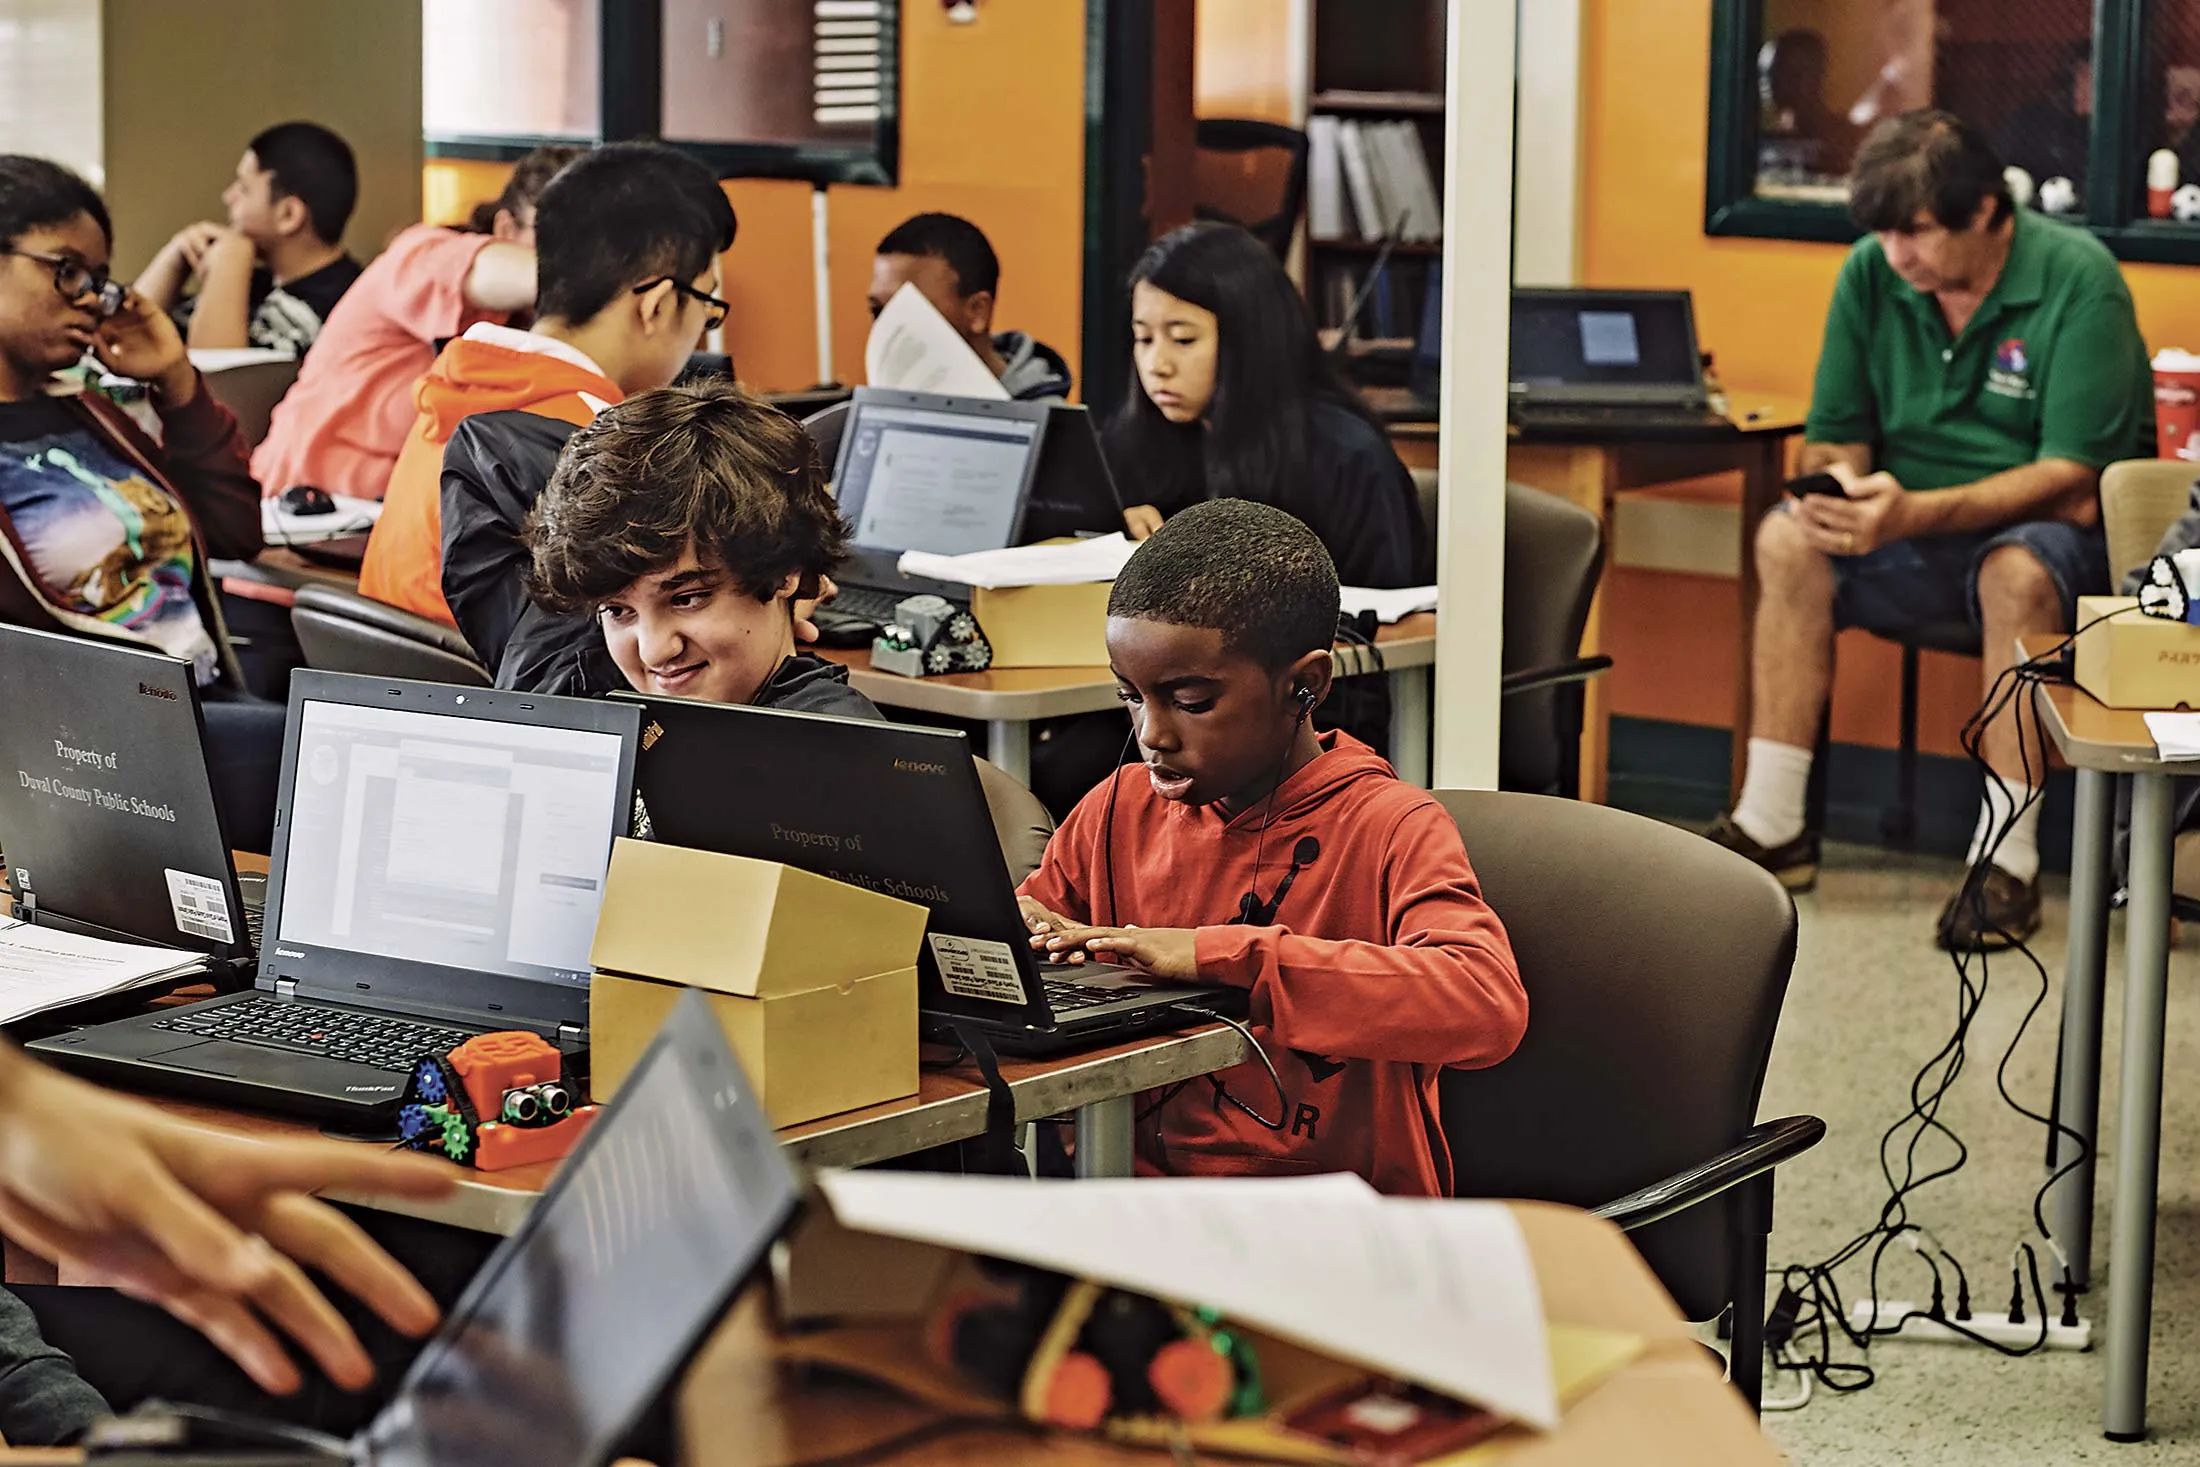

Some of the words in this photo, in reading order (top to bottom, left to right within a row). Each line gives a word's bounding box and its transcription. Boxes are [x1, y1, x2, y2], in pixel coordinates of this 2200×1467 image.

[54, 739, 102, 769] Property
[104, 752, 118, 769] of
[17, 770, 53, 794] Duval
[52, 778, 92, 807] County
[92, 788, 131, 810] Public
[130, 796, 176, 822] Schools
[770, 823, 840, 851] Property
[845, 835, 863, 851] of
[883, 878, 950, 902] Schools
